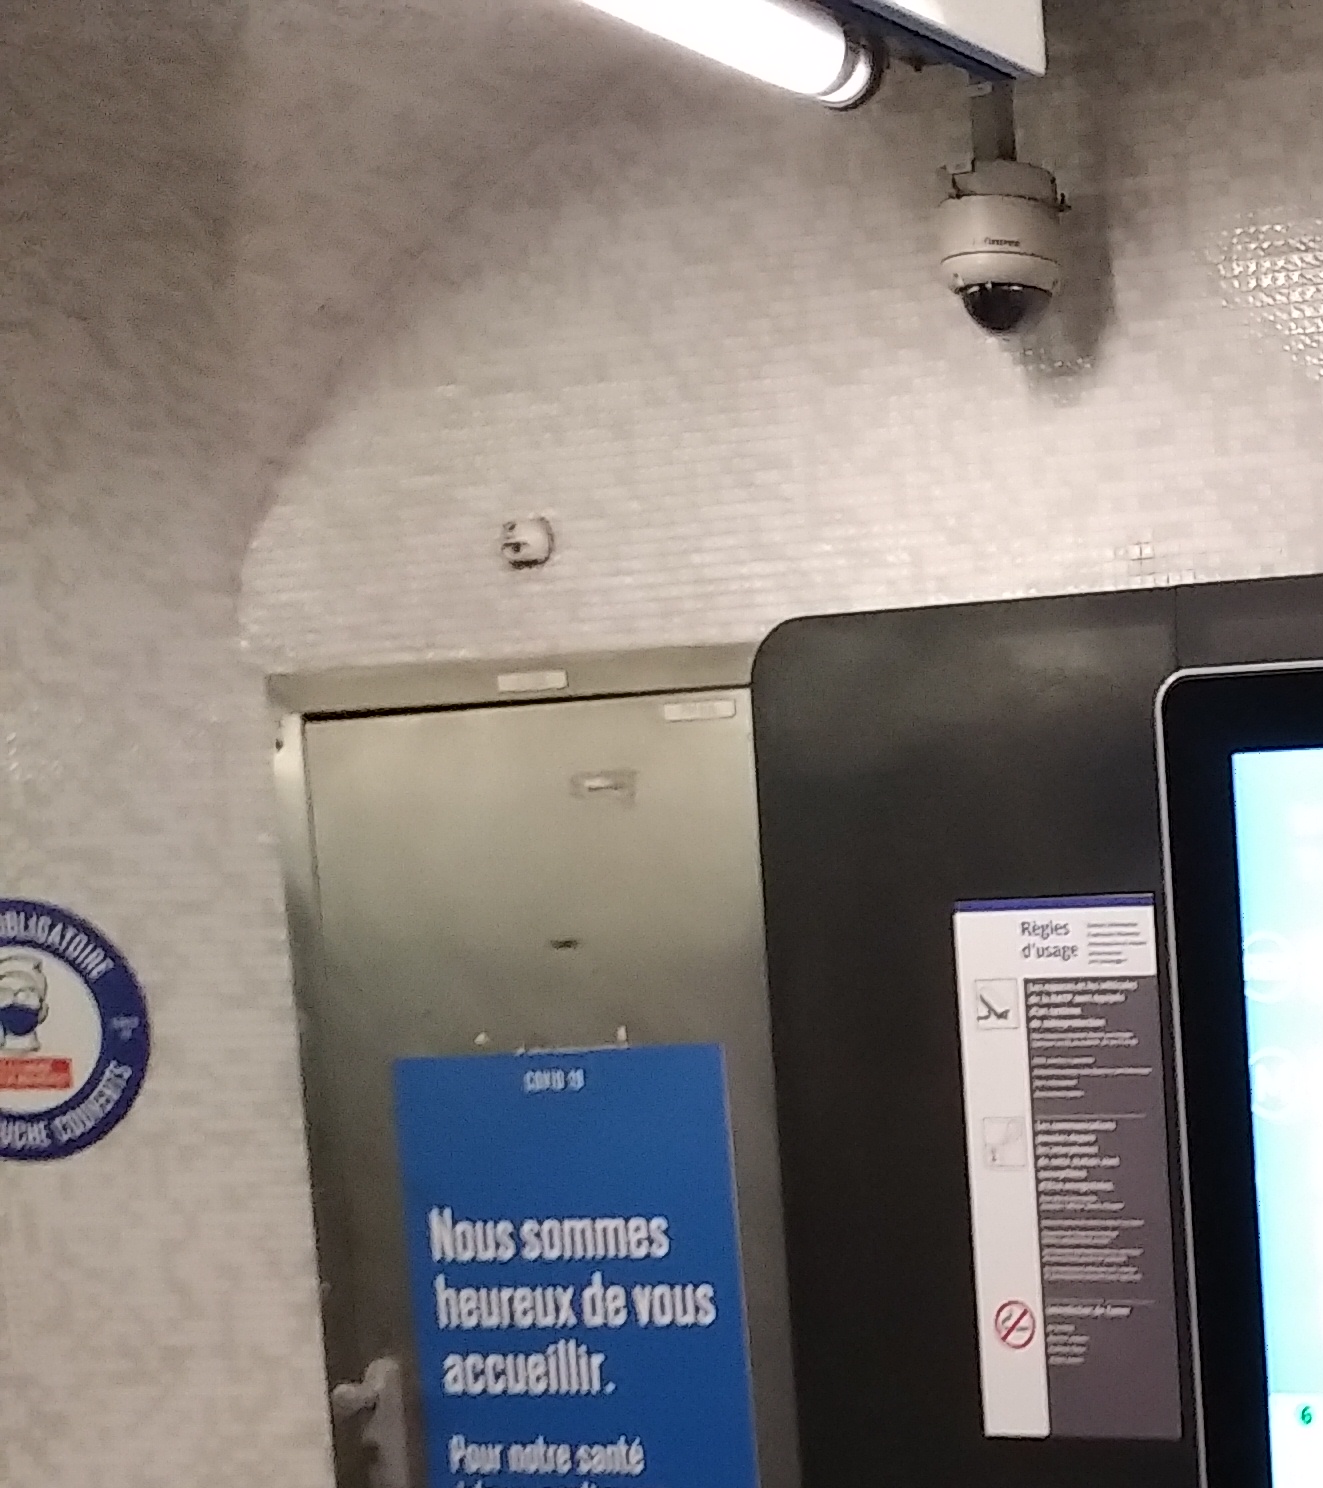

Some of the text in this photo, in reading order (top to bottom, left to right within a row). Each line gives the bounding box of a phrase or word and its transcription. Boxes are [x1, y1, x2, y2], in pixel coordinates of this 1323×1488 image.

[1020, 920, 1071, 940] Règles
[1021, 942, 1079, 961] d'usage
[428, 1205, 670, 1263] Nous sommes
[434, 1270, 717, 1330] heureux de vous
[442, 1338, 616, 1396] accueillir.
[1300, 1404, 1313, 1426] 6
[450, 1434, 645, 1476] Pour notre santé
